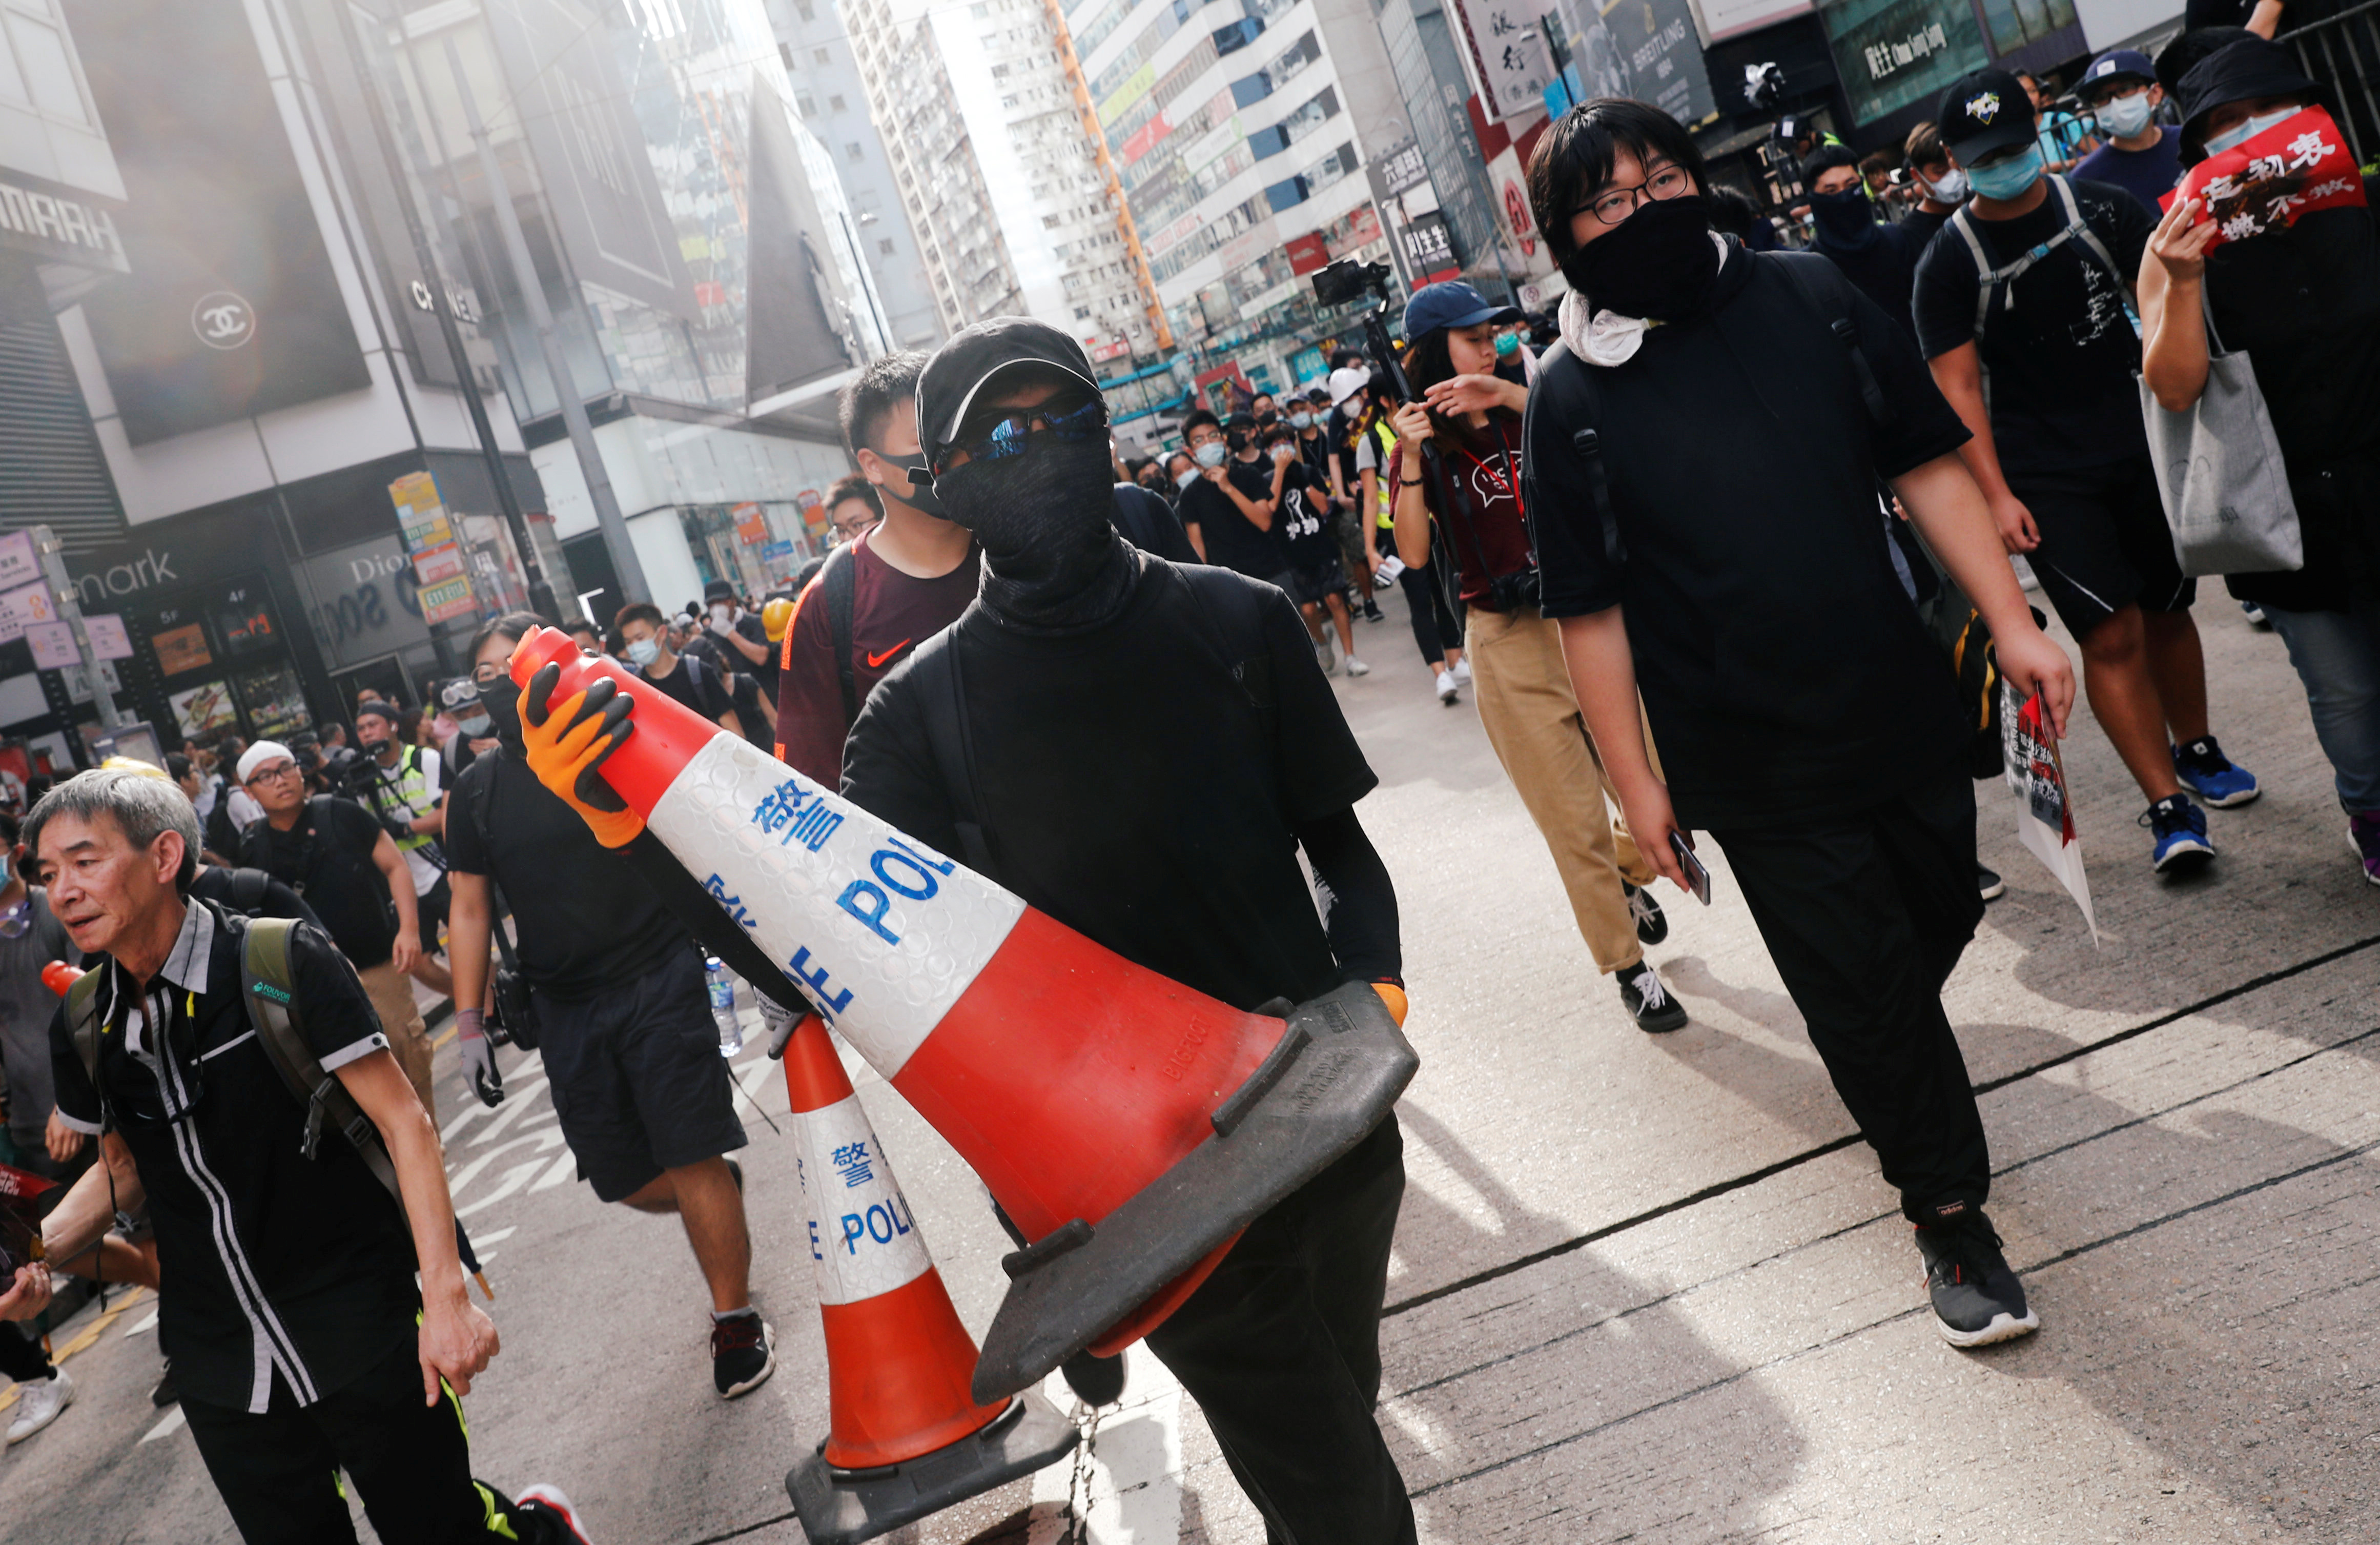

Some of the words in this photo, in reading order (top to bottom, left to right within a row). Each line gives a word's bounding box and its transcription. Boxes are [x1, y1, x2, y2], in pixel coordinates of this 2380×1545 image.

[1632, 18, 1685, 72] BREITLING
[2184, 129, 2336, 227] 忘初衷
[751, 779, 845, 853] 警
[1163, 1013, 1208, 1082] BIGFOOT
[830, 1142, 874, 1188] 警
